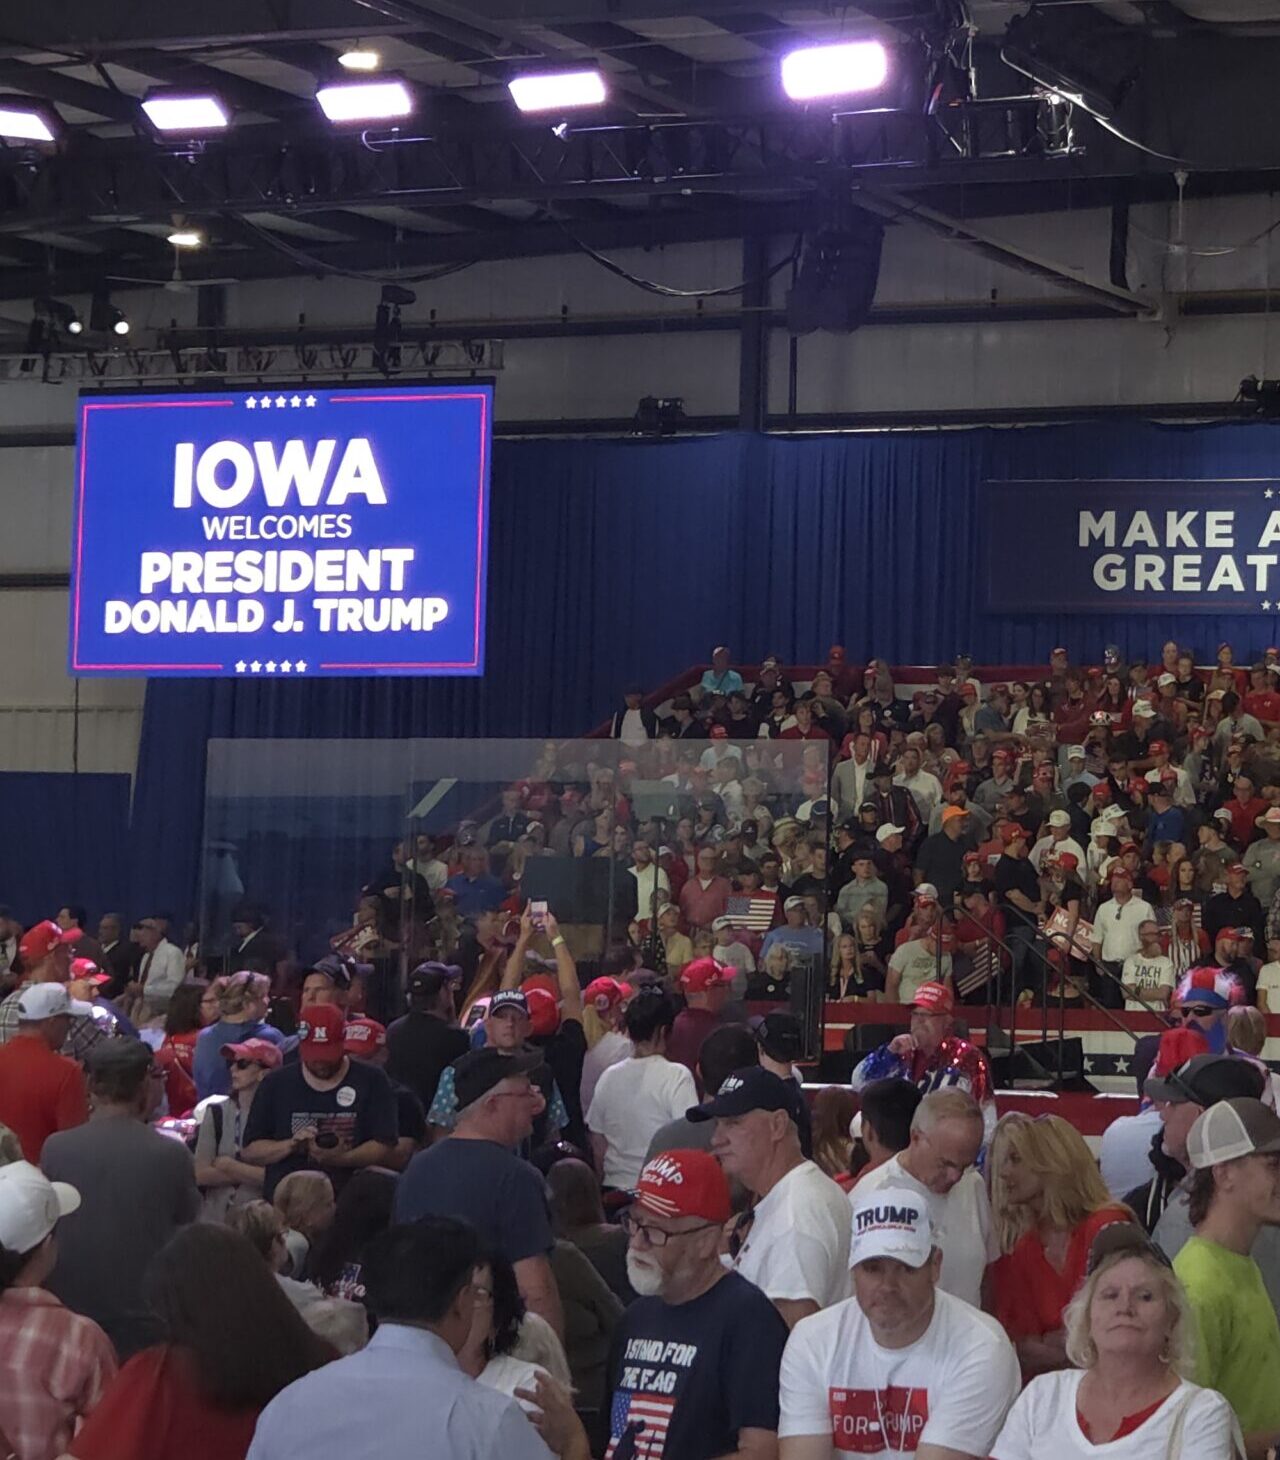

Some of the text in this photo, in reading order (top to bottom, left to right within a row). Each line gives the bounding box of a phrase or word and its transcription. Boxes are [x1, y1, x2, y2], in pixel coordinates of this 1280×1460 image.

[173, 438, 388, 508] IOWA
[201, 513, 352, 541] WELCOMES
[1079, 510, 1235, 547] MAKE
[140, 547, 415, 594] PRESIDENT
[1093, 553, 1278, 592] GREAT
[104, 597, 449, 634] DONALD J. TRUMP
[1134, 964, 1161, 978] ZACH
[493, 991, 524, 1003] TRUMP
[856, 1206, 919, 1230] TRUMP
[661, 1341, 697, 1367] FOR
[833, 1414, 868, 1435] FOR
